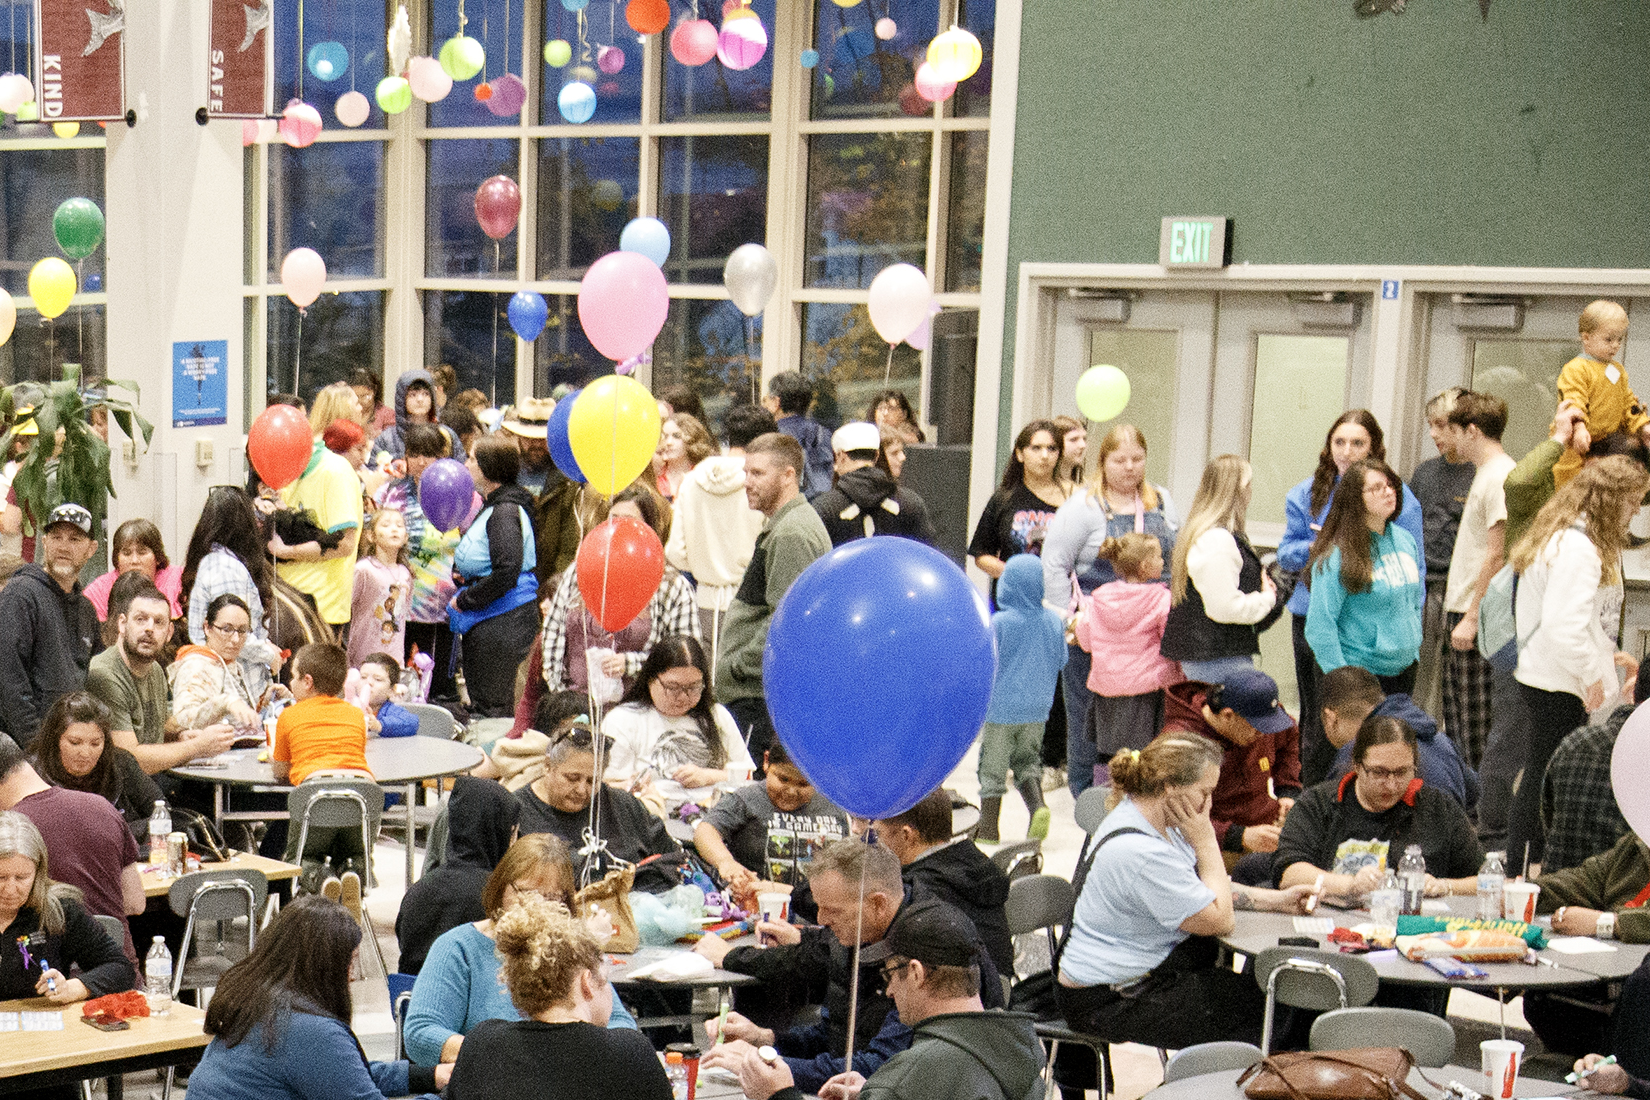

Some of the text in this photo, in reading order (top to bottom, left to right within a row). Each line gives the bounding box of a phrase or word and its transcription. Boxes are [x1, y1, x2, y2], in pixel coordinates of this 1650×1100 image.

[43, 54, 63, 117] KIND
[211, 49, 224, 112] SAFE
[1170, 222, 1213, 263] EXIT
[1386, 281, 1396, 298] 2
[773, 812, 837, 825] EVERY DAY
[786, 822, 820, 832] GAME
